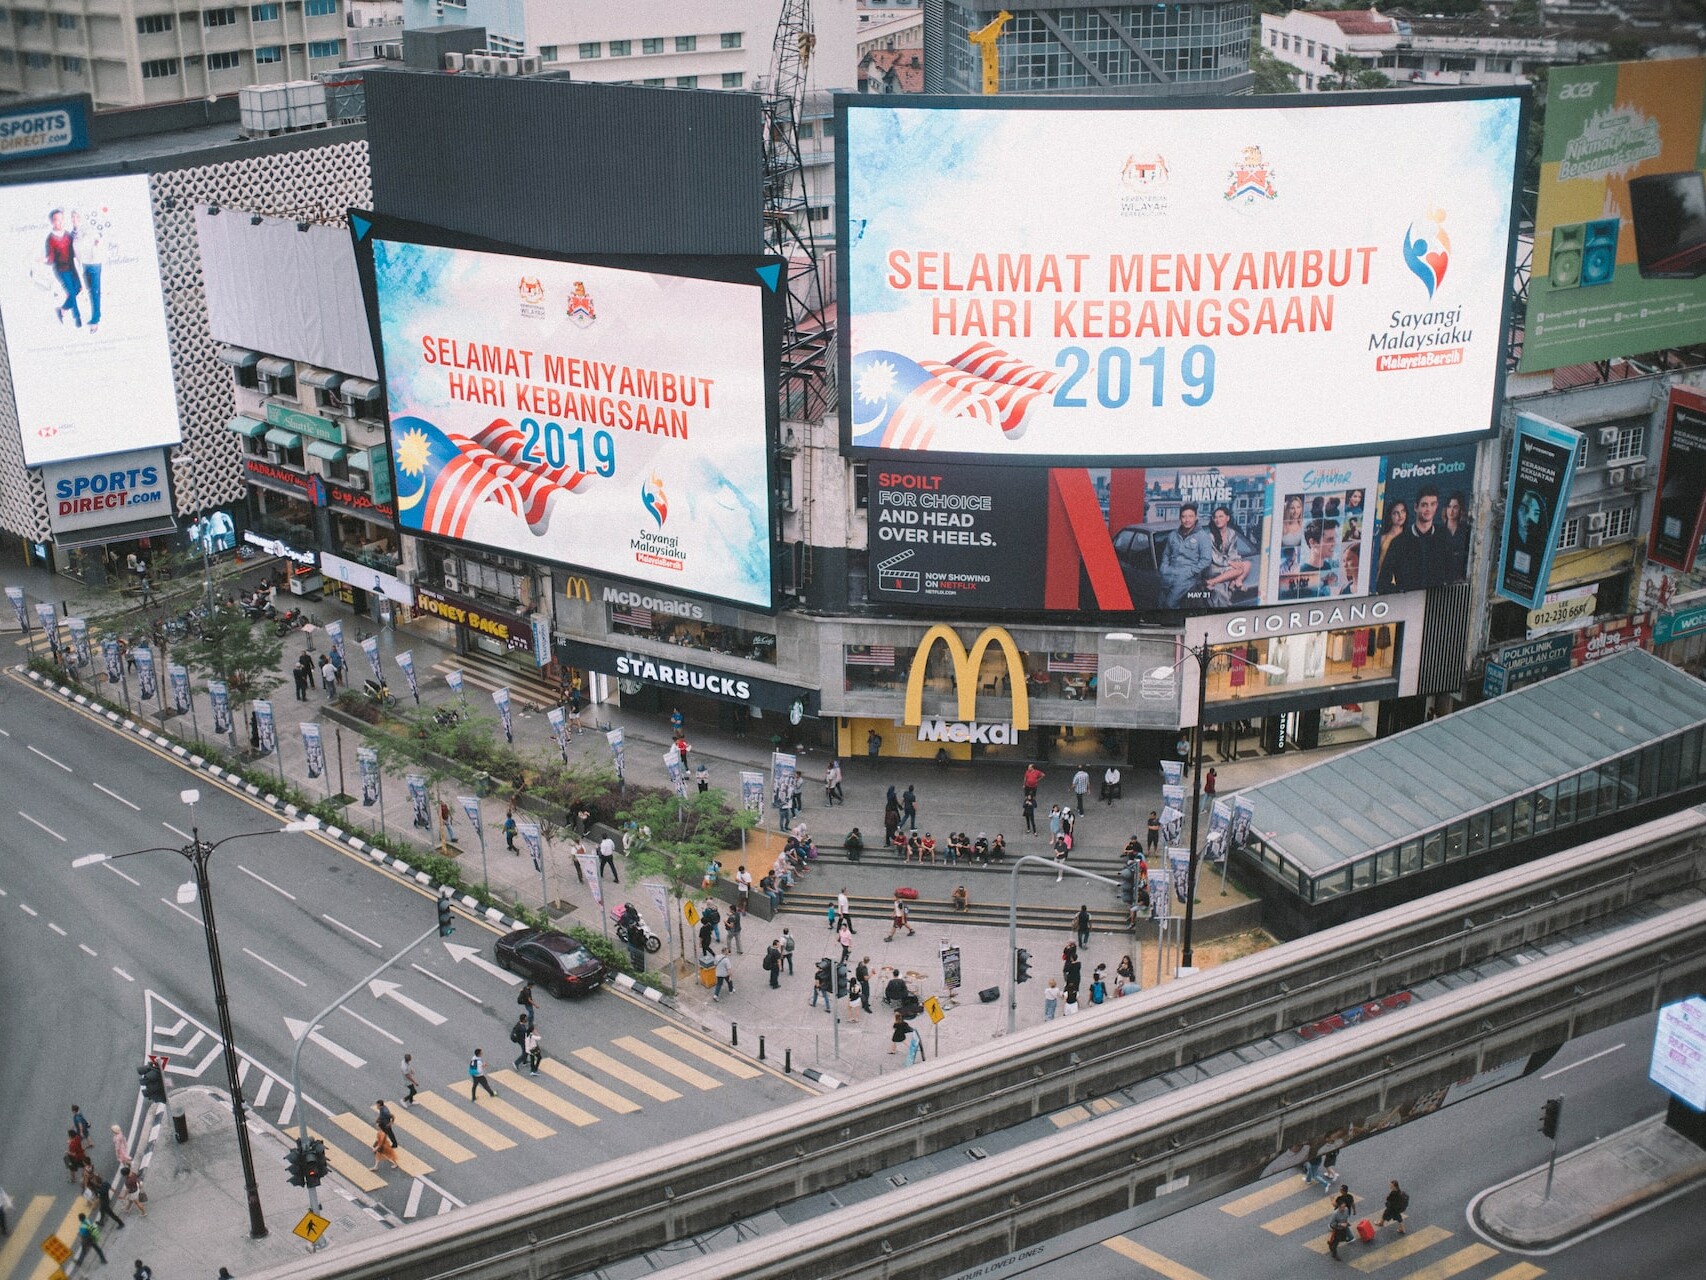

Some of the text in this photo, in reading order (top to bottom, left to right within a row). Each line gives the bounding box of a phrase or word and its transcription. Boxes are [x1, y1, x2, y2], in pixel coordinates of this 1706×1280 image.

[1559, 81, 1599, 99] acer
[0, 114, 65, 137] SPORTS
[887, 246, 1379, 293] SELAMAT MENYAMBUT
[932, 294, 1335, 338] HARI KEBANGSAAN
[1390, 304, 1462, 330] Sayangi
[1368, 326, 1473, 351] Malaysiaku
[1380, 350, 1461, 370] MalaysiaBersih
[422, 335, 715, 409] SELAMAT MENYAMBUT
[1053, 344, 1217, 409] 2019
[448, 371, 689, 440] HARI KEBANGSAAN
[520, 417, 617, 479] 2019
[1392, 460, 1466, 480] Perfect Date
[1520, 466, 1555, 483] KEKUATAN
[1520, 473, 1539, 484] ANDA
[1521, 460, 1556, 476] KERAHKAN
[56, 467, 158, 498] SPORTS
[879, 473, 943, 490] SPOILT
[1179, 474, 1226, 489] ALWAYS
[58, 490, 161, 516] DIRECT.COM
[879, 490, 992, 511] FOR CHOICE
[1192, 487, 1233, 502] MAYBE
[879, 509, 974, 527] AND HEAD
[640, 529, 679, 547] Sayangi
[879, 527, 997, 547] OVER HEELS.
[630, 539, 687, 560] Malaysiaku
[925, 572, 991, 583] NOW SHOWING
[925, 580, 977, 590] ON NETFLIX
[603, 587, 704, 619] McDonald's
[1187, 591, 1201, 599] MAY
[1546, 594, 1559, 603] LET
[418, 594, 509, 639] HONEY BAKE
[1226, 601, 1390, 638] GIORDANO
[1534, 608, 1567, 625] 012-230
[1503, 647, 1568, 669] KUMPULAN CITY
[1504, 641, 1552, 660] POLIKLINIK
[616, 656, 751, 700] STARBUCKS
[918, 720, 1020, 746] Mekdi
[984, 1257, 1016, 1274] LOVED
[1018, 1245, 1045, 1261] ONES
